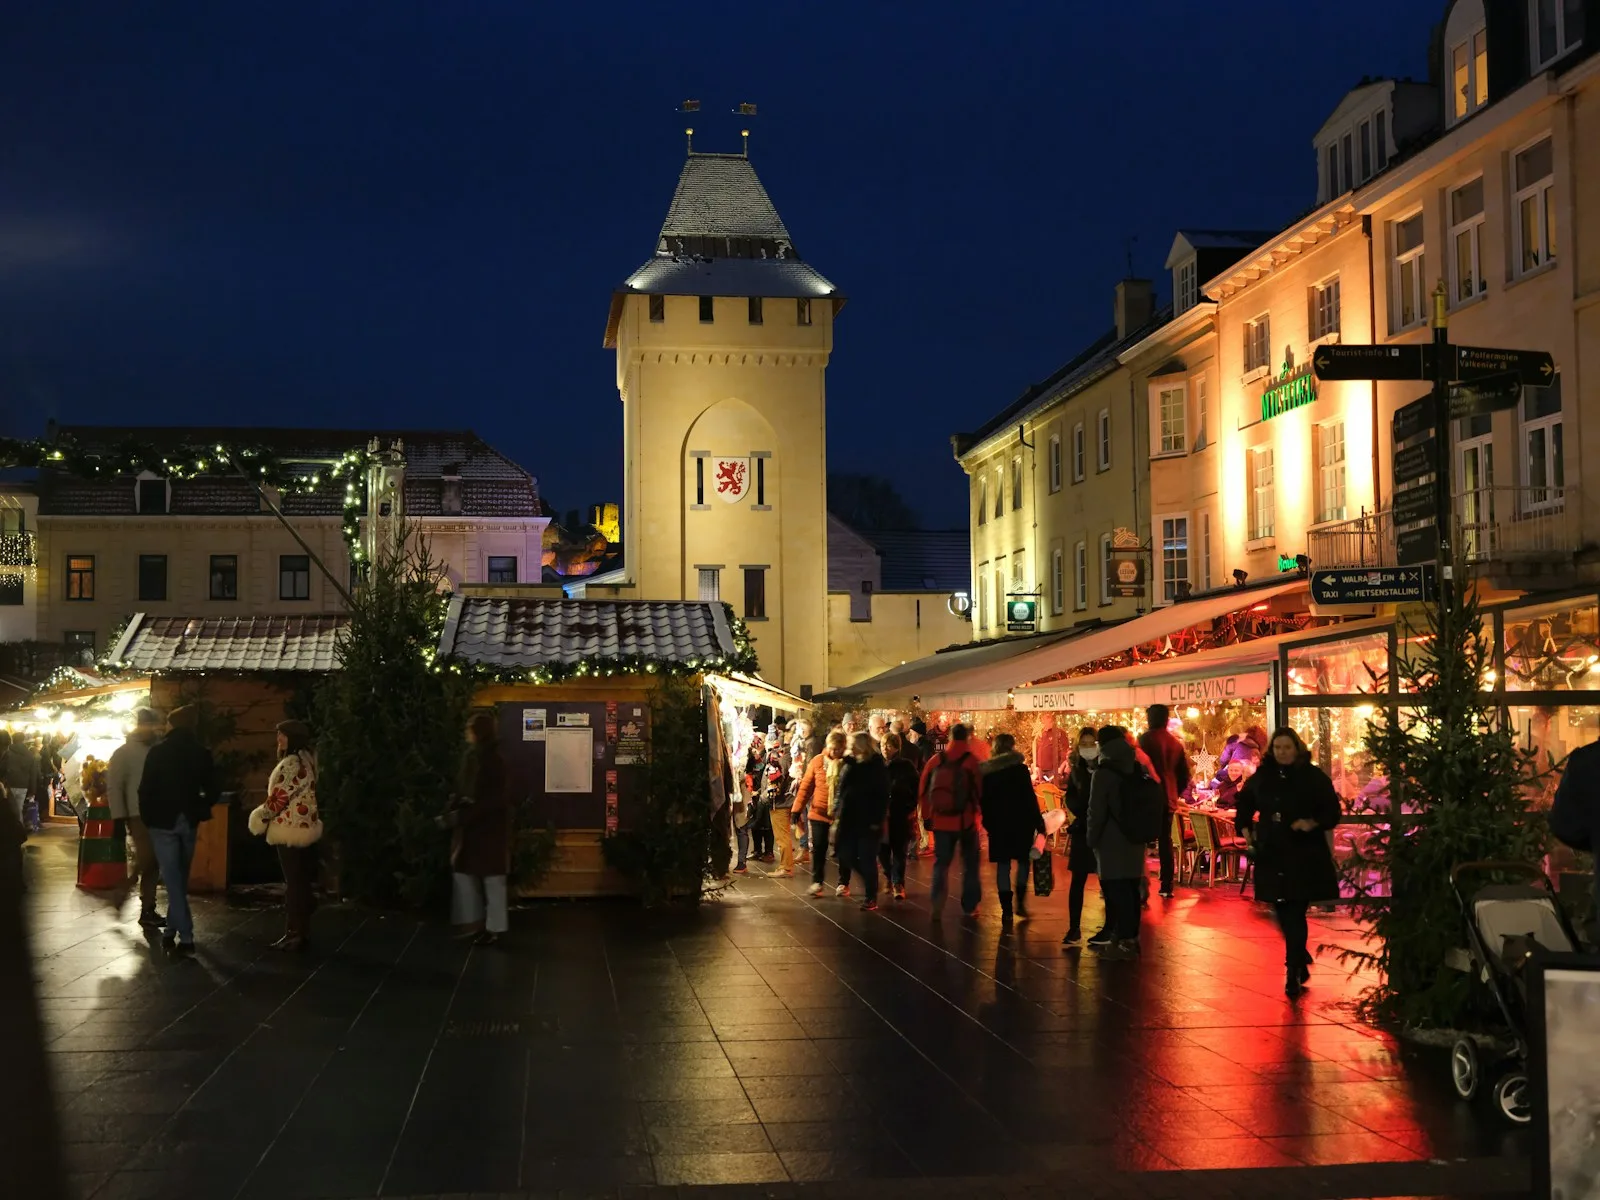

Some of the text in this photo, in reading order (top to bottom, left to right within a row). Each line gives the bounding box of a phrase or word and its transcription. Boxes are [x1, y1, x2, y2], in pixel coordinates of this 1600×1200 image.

[1331, 348, 1383, 357] Tourist-info
[1470, 350, 1518, 361] Polfermolen
[1460, 359, 1497, 369] Valkenier
[1261, 373, 1315, 422] MICHIEL
[1342, 573, 1395, 583] WALRALEIN
[1354, 587, 1419, 598] FIETSENSTALLING
[1170, 677, 1236, 701] CUP&VINO
